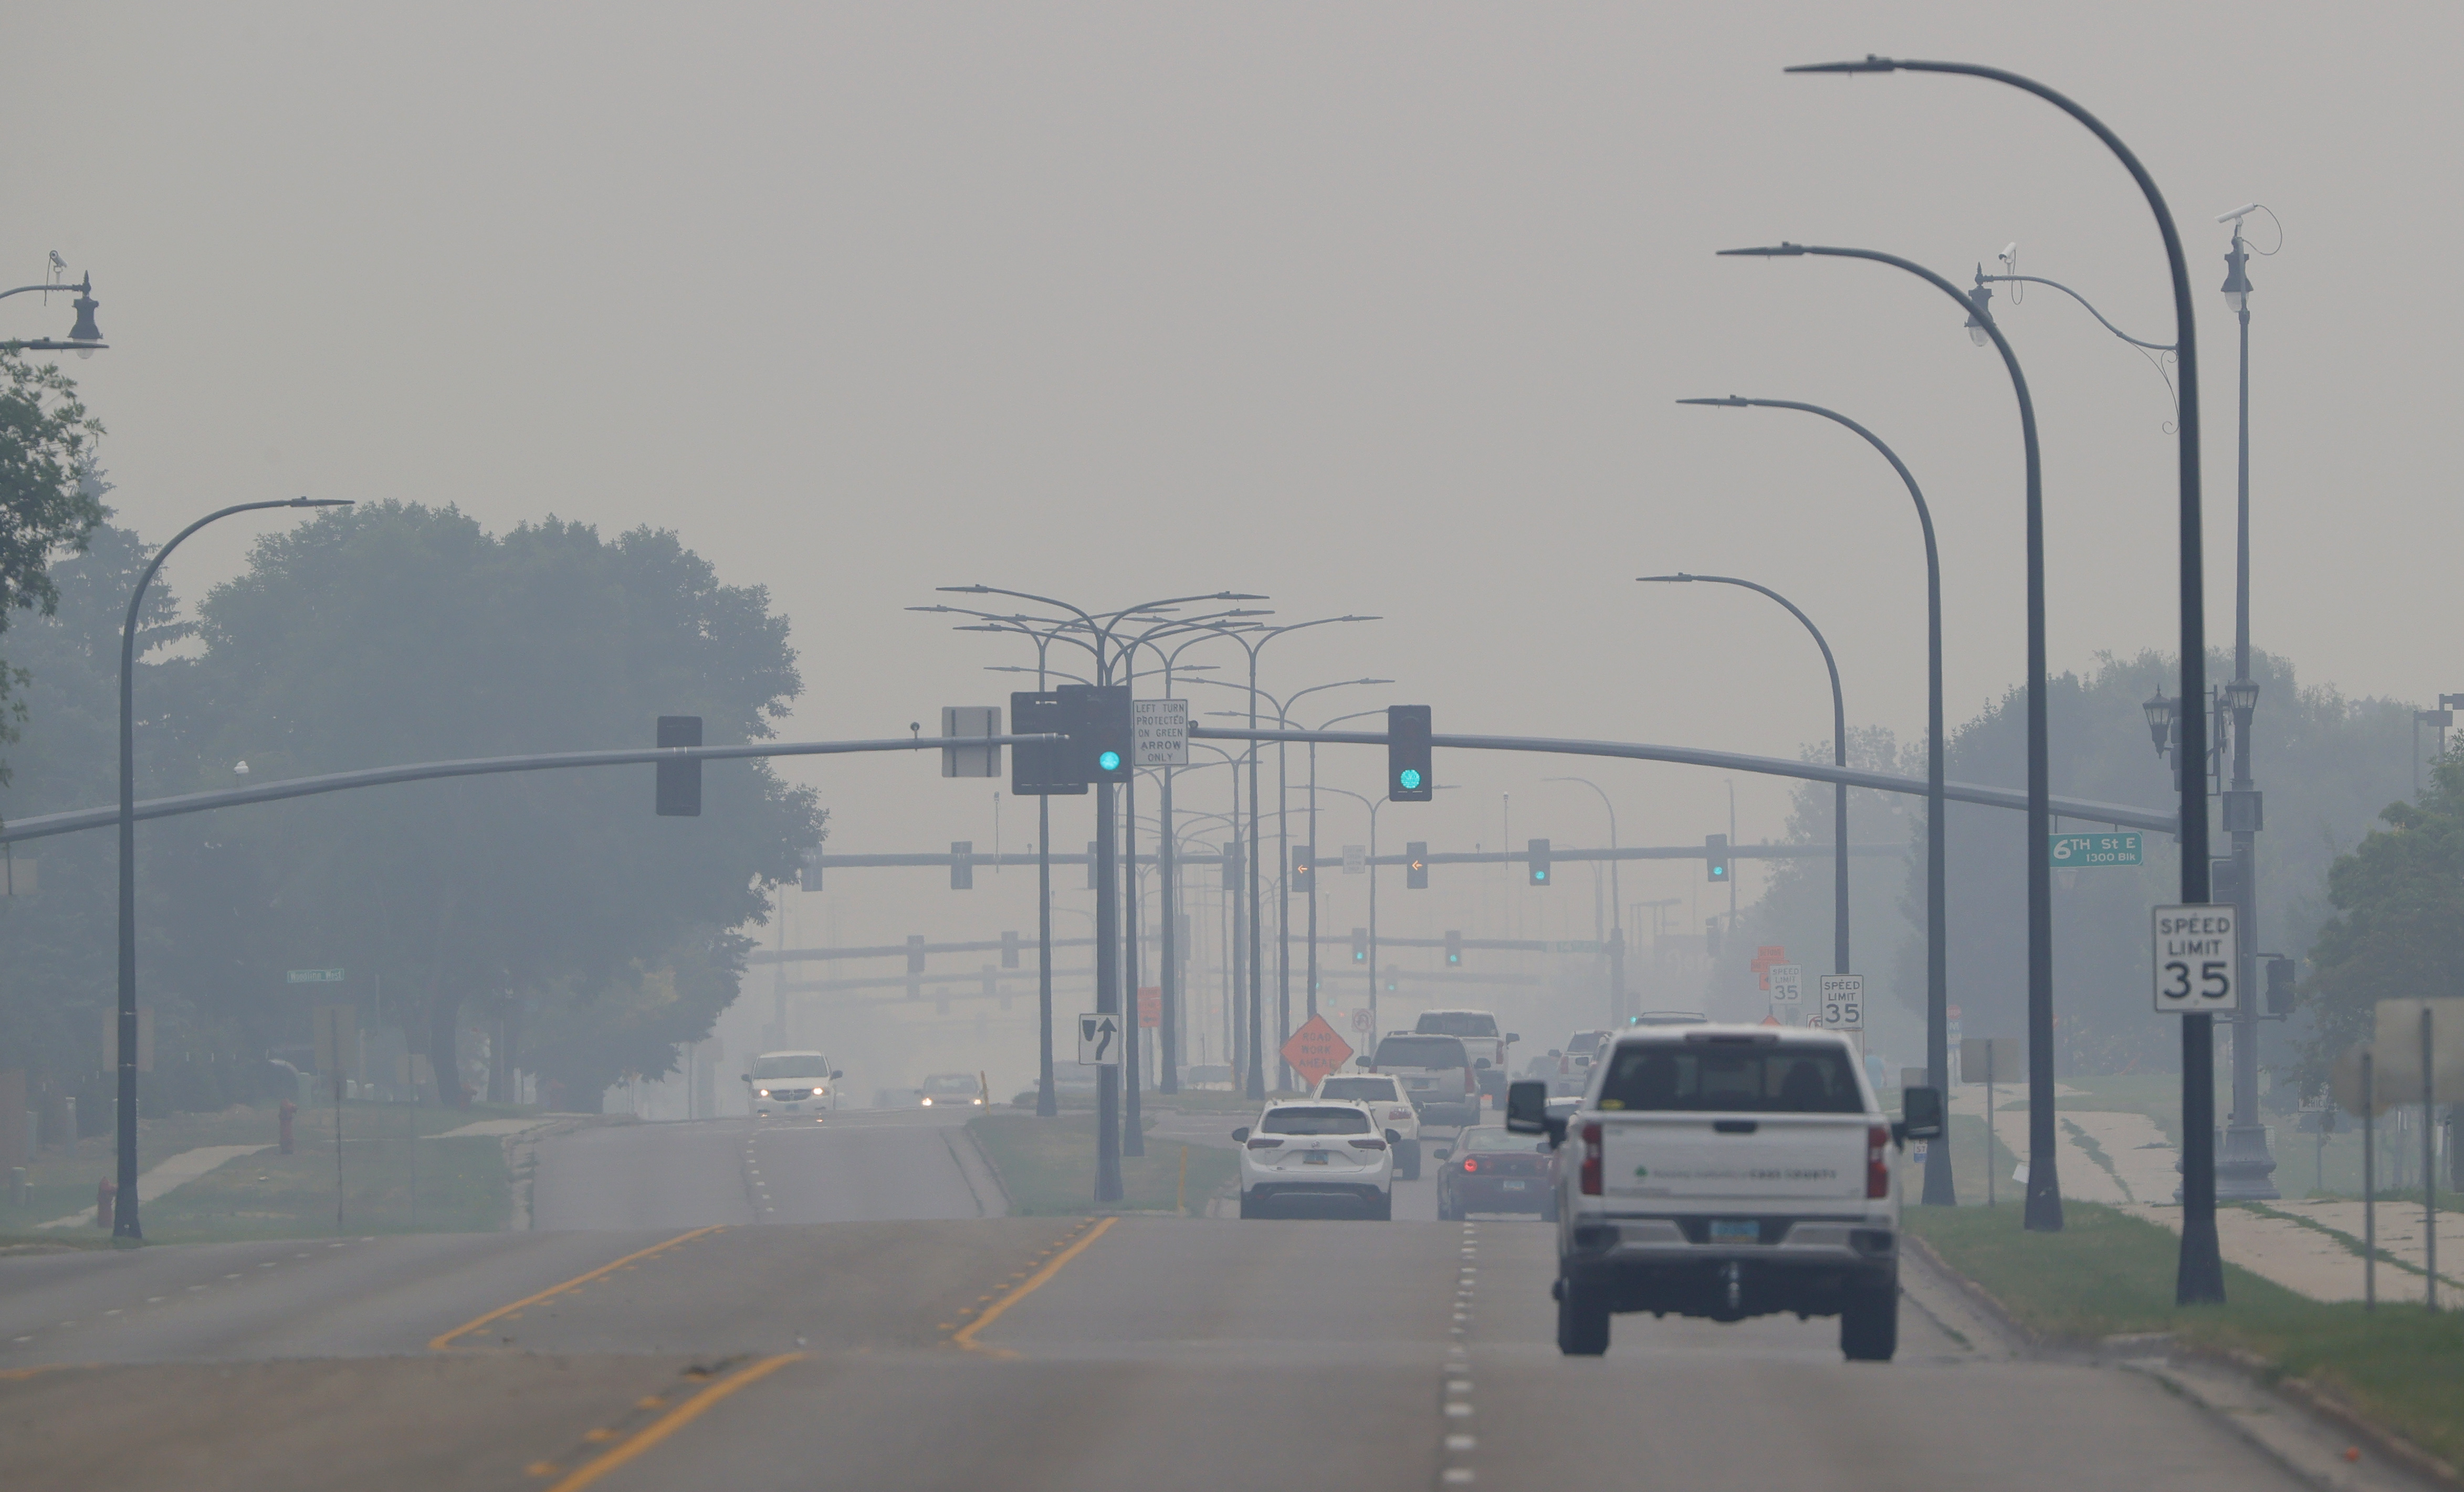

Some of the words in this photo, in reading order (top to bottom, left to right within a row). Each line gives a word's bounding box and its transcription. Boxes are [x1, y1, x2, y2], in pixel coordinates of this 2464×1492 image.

[1136, 704, 1156, 712] LEFT
[1163, 703, 1184, 712] TURN
[1137, 716, 1183, 725] PROTECTED
[1138, 729, 1150, 737] ON
[1156, 728, 1182, 737] GREEN
[1140, 740, 1181, 750] ARROW
[1148, 753, 1173, 762] ONLY
[2053, 839, 2090, 859] 6TH
[2101, 838, 2119, 849] St
[2126, 837, 2136, 849] E
[2086, 853, 2115, 862] 1300
[2118, 853, 2136, 861] Blk
[2161, 917, 2230, 934] SPEED
[2169, 939, 2221, 956] LIMIT
[2163, 960, 2230, 999] 35
[1825, 981, 1860, 990] SPEED
[1775, 985, 1798, 1000] 35
[1828, 992, 1856, 1001] LIMIT
[1826, 1003, 1859, 1023] 35
[1303, 1032, 1331, 1041] ROAD
[1302, 1045, 1331, 1054] WORK
